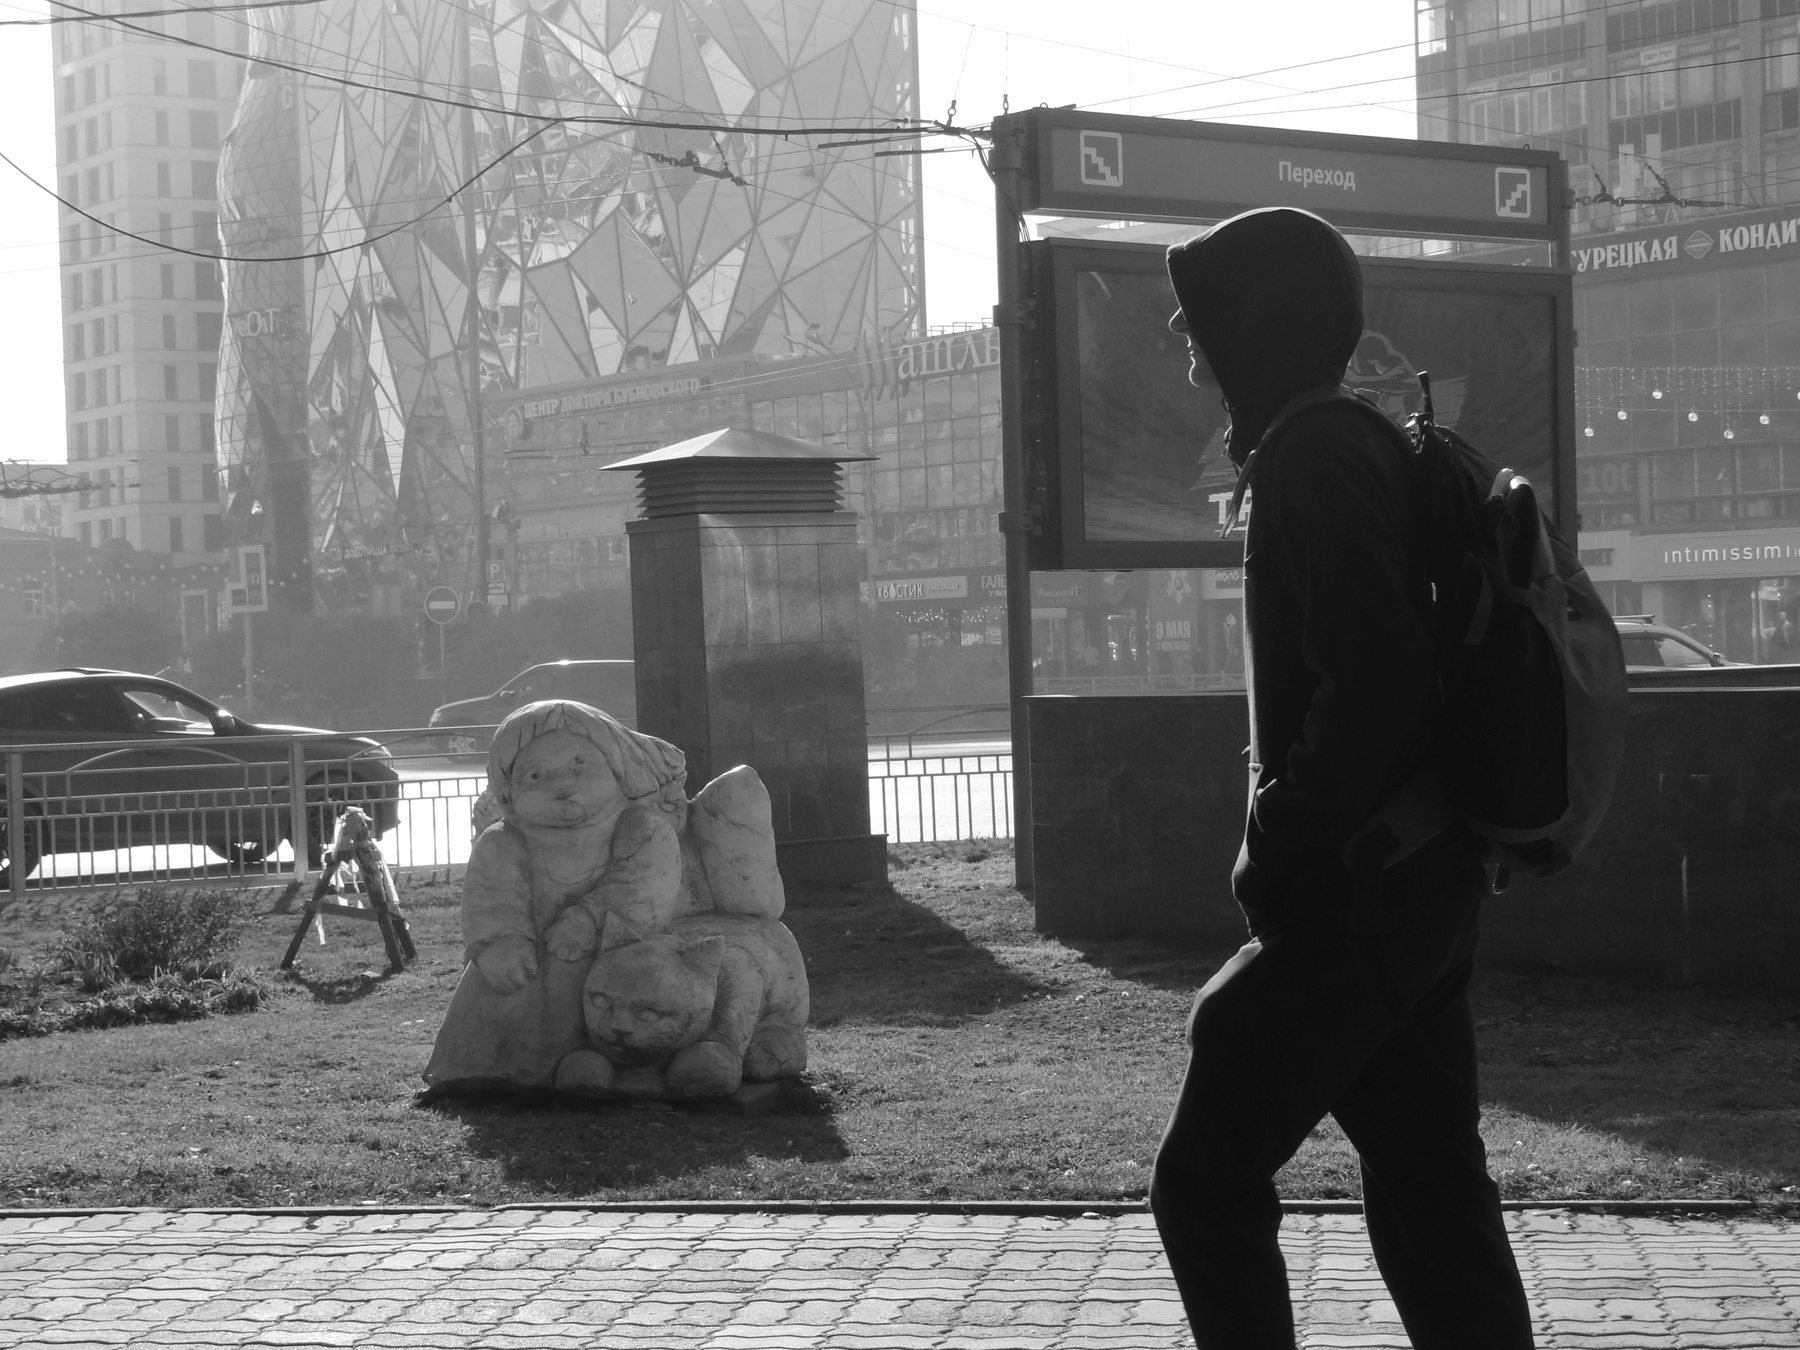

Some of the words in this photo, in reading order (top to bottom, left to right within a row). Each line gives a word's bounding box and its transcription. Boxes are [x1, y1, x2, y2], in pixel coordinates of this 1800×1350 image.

[1278, 160, 1356, 192] Переход
[1571, 236, 1678, 272] УРЕЦКАЯ
[524, 398, 558, 418] ЦЕНТР
[561, 391, 611, 414] ДОКТОРА
[613, 377, 700, 404] БУБНОВСКОГО
[1664, 545, 1790, 564] intimissimi
[1156, 621, 1163, 640] 9
[1166, 620, 1190, 639] МАЯ
